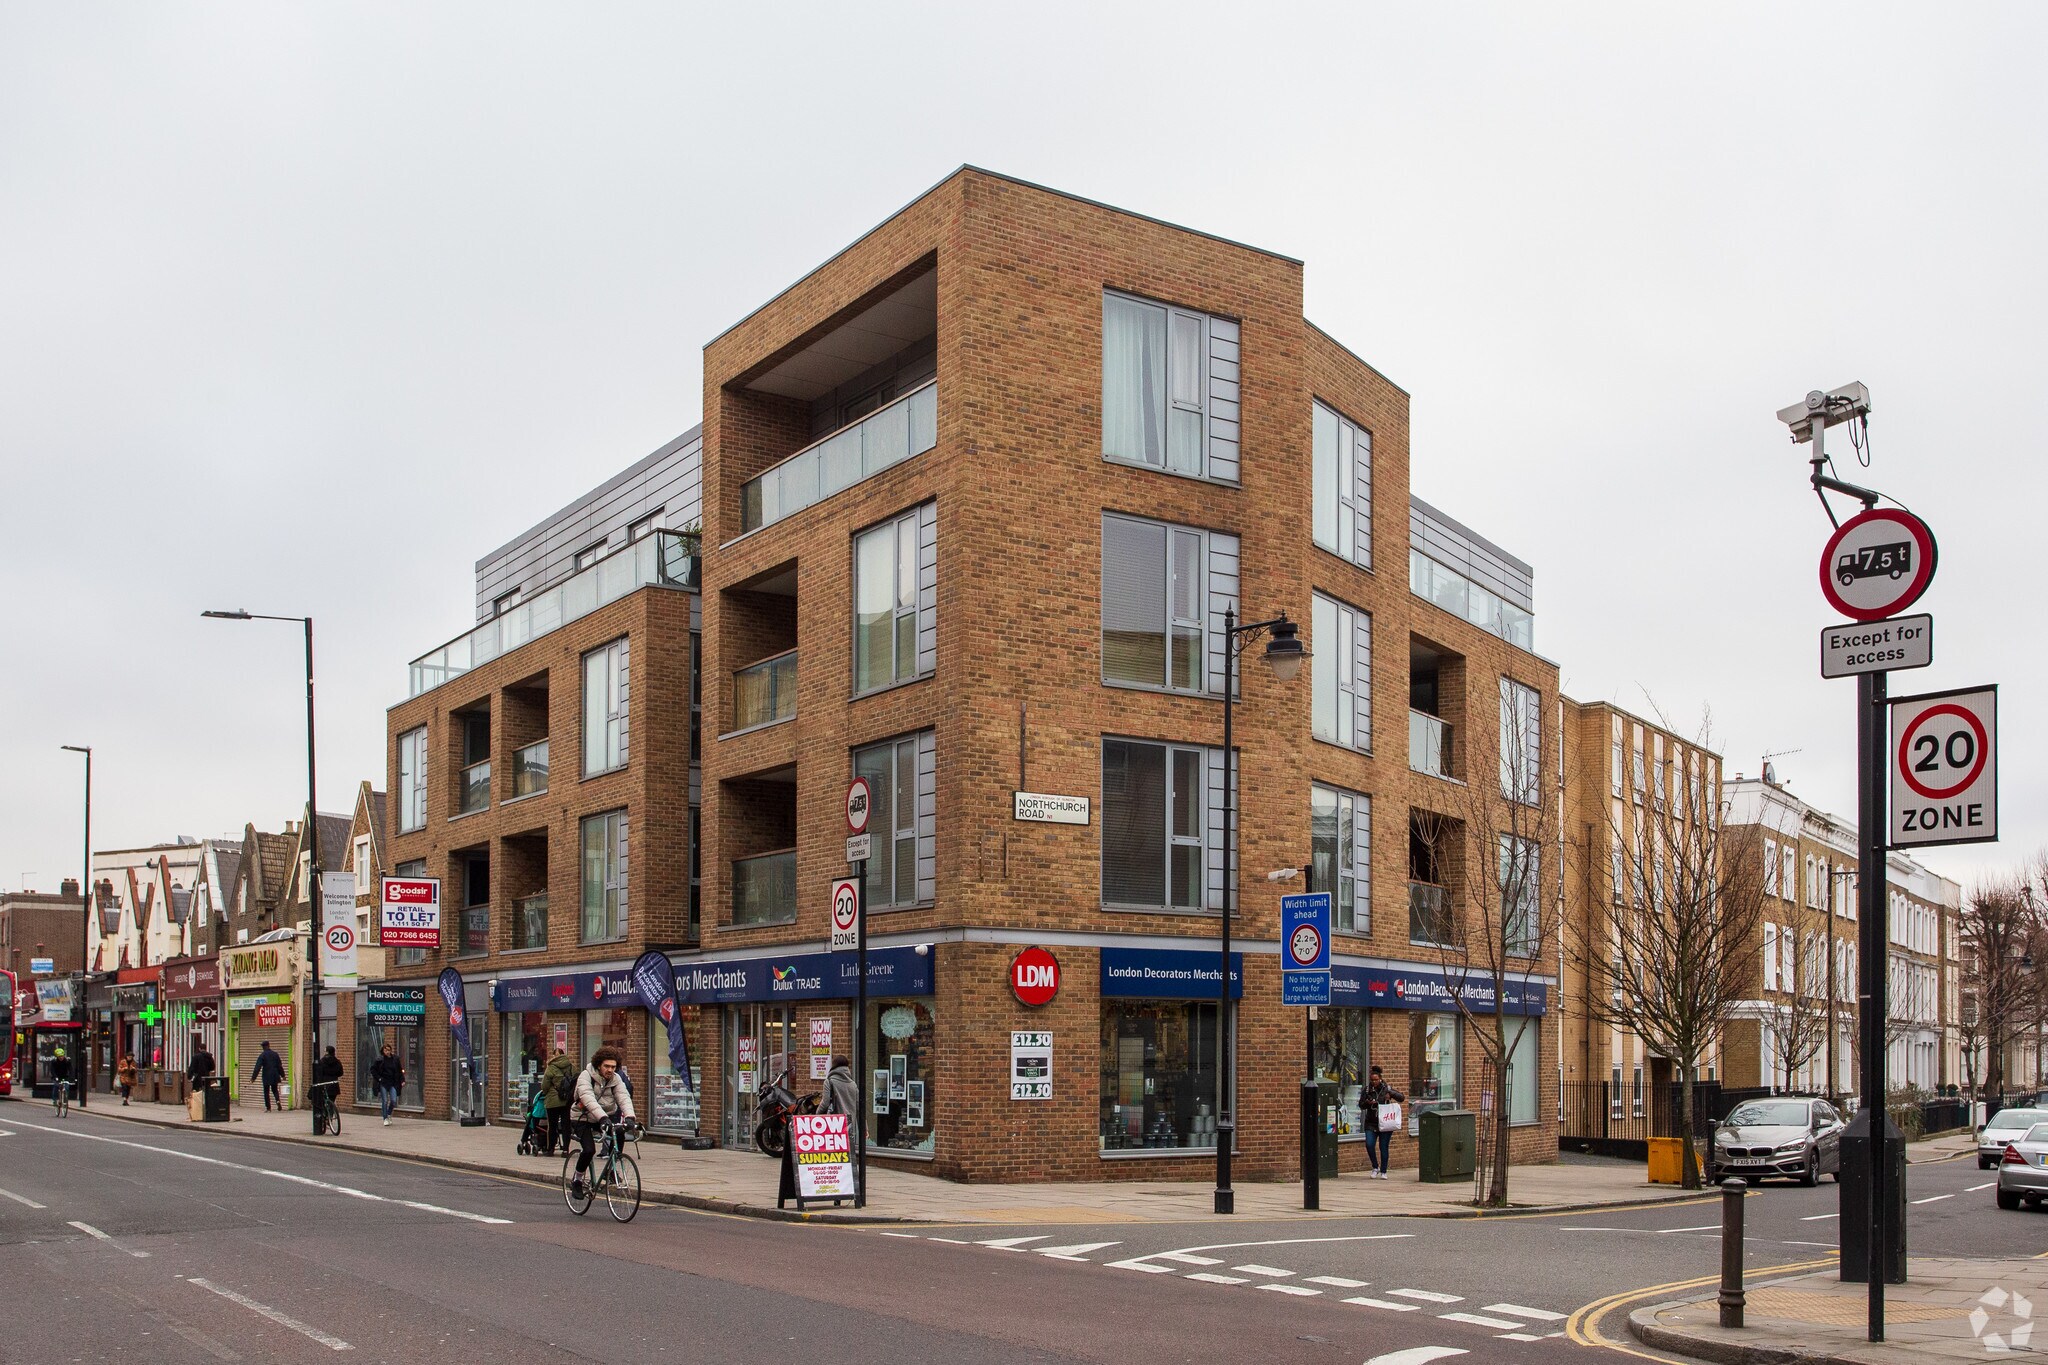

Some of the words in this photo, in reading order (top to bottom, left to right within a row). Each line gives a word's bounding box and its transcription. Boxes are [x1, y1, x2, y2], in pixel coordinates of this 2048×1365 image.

[1861, 549, 1892, 571] 7.5
[1898, 546, 1906, 561] t
[1830, 629, 1890, 650] Except
[1896, 626, 1922, 641] for
[1846, 648, 1905, 666] access
[1914, 730, 1974, 772] 20
[1019, 799, 1086, 812] NORTHCHURCH
[1019, 808, 1044, 818] ROAD
[1902, 803, 1983, 832] ZONE
[848, 839, 862, 848] Except
[852, 849, 865, 857] access
[389, 884, 428, 900] goodsir
[837, 896, 853, 916] 20
[1284, 900, 1307, 908] Width
[1310, 899, 1327, 907] limit
[386, 912, 405, 921] TO
[410, 912, 436, 922] LET
[1294, 910, 1318, 919] ahead
[331, 931, 349, 944] 20
[834, 933, 856, 945] ZONE
[692, 968, 746, 990] Merchants
[1017, 965, 1054, 988] LDM
[1108, 966, 1142, 977] London
[1144, 967, 1192, 979] Decorators
[1194, 969, 1238, 980] Merchats
[638, 966, 662, 1000] Decorators
[648, 970, 666, 995] London
[773, 980, 793, 991] Dulux
[796, 978, 821, 989] TRADE
[913, 979, 924, 988] 316
[1300, 976, 1324, 985] through
[369, 990, 424, 999] Harston&Co
[635, 972, 657, 1005] Merchants
[1404, 980, 1429, 995] London
[1465, 984, 1494, 1000] Merchants
[1285, 994, 1300, 1002] large
[1302, 993, 1327, 1001] vehicles
[260, 1006, 291, 1017] CHINESE
[262, 1017, 290, 1025] TAKE-AWAY
[812, 1021, 830, 1033] NOW
[812, 1034, 830, 1046] OPEN
[1013, 1034, 1050, 1046] £12.50
[1013, 1084, 1050, 1097] £12.50
[796, 1116, 845, 1134] NOW
[798, 1134, 847, 1151] OPEN
[800, 1152, 849, 1164] SUNDAYS
